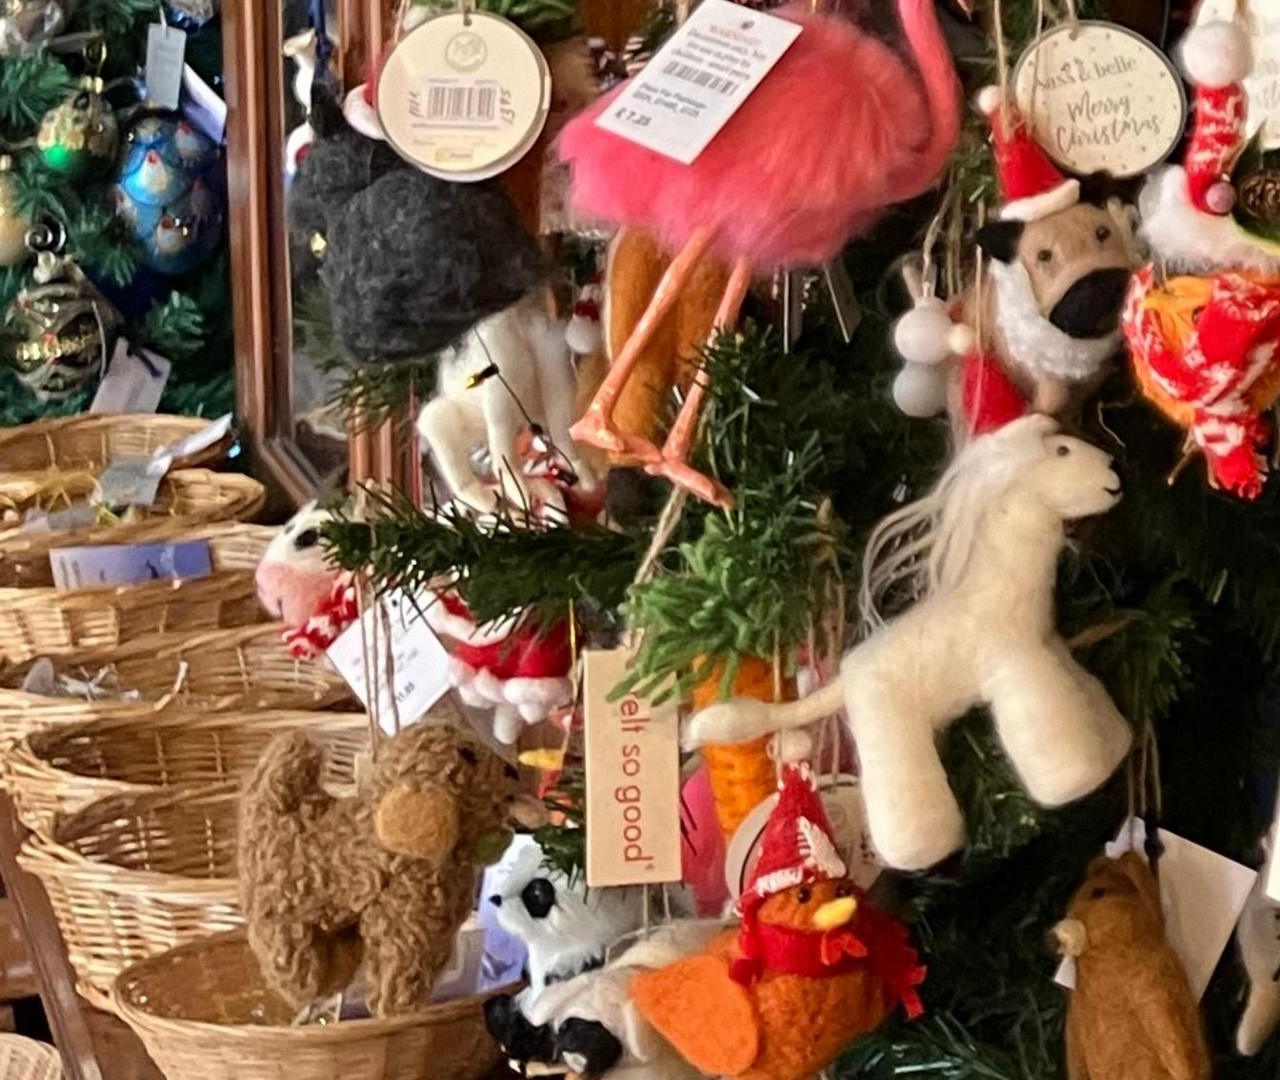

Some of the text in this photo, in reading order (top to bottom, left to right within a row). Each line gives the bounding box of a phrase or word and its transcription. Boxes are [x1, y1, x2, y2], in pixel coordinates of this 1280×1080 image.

[1066, 89, 1131, 124] Merry
[1056, 114, 1162, 156] Christmas
[620, 696, 651, 735] elt
[621, 742, 642, 778] so
